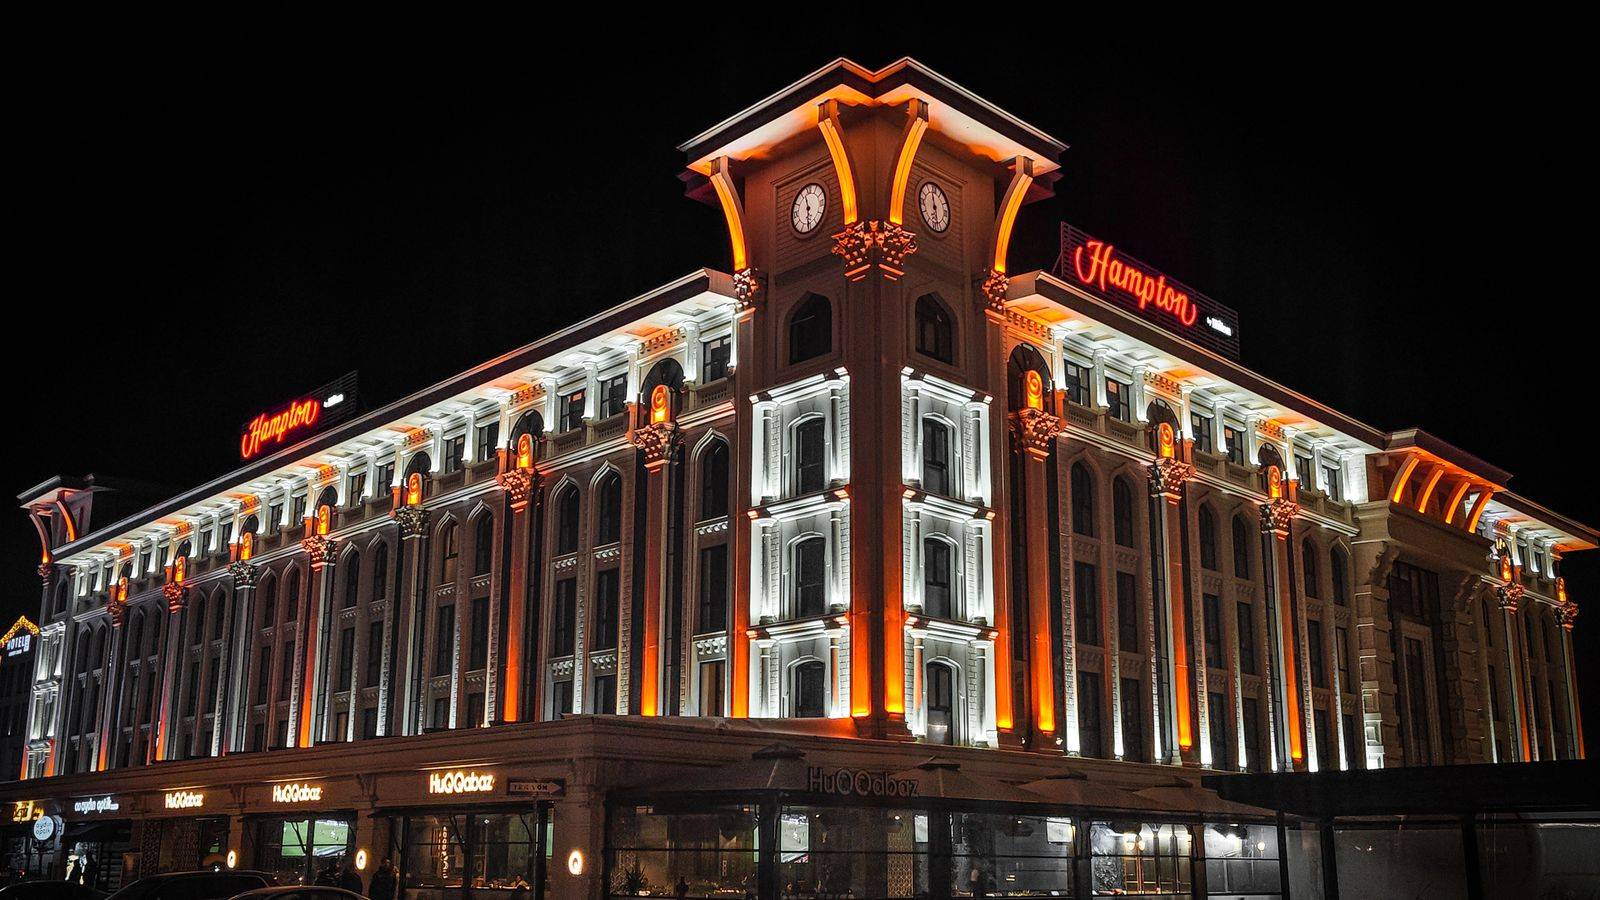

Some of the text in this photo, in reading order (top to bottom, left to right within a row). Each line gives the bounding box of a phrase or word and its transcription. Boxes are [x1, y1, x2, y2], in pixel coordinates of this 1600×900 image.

[1076, 240, 1197, 326] Hampton
[241, 400, 318, 458] Hampton
[272, 783, 322, 803] HuQQabaz
[429, 771, 494, 794] HuQQabaz
[809, 766, 920, 797] HuQQabaz
[165, 791, 204, 808] HuQQabaz
